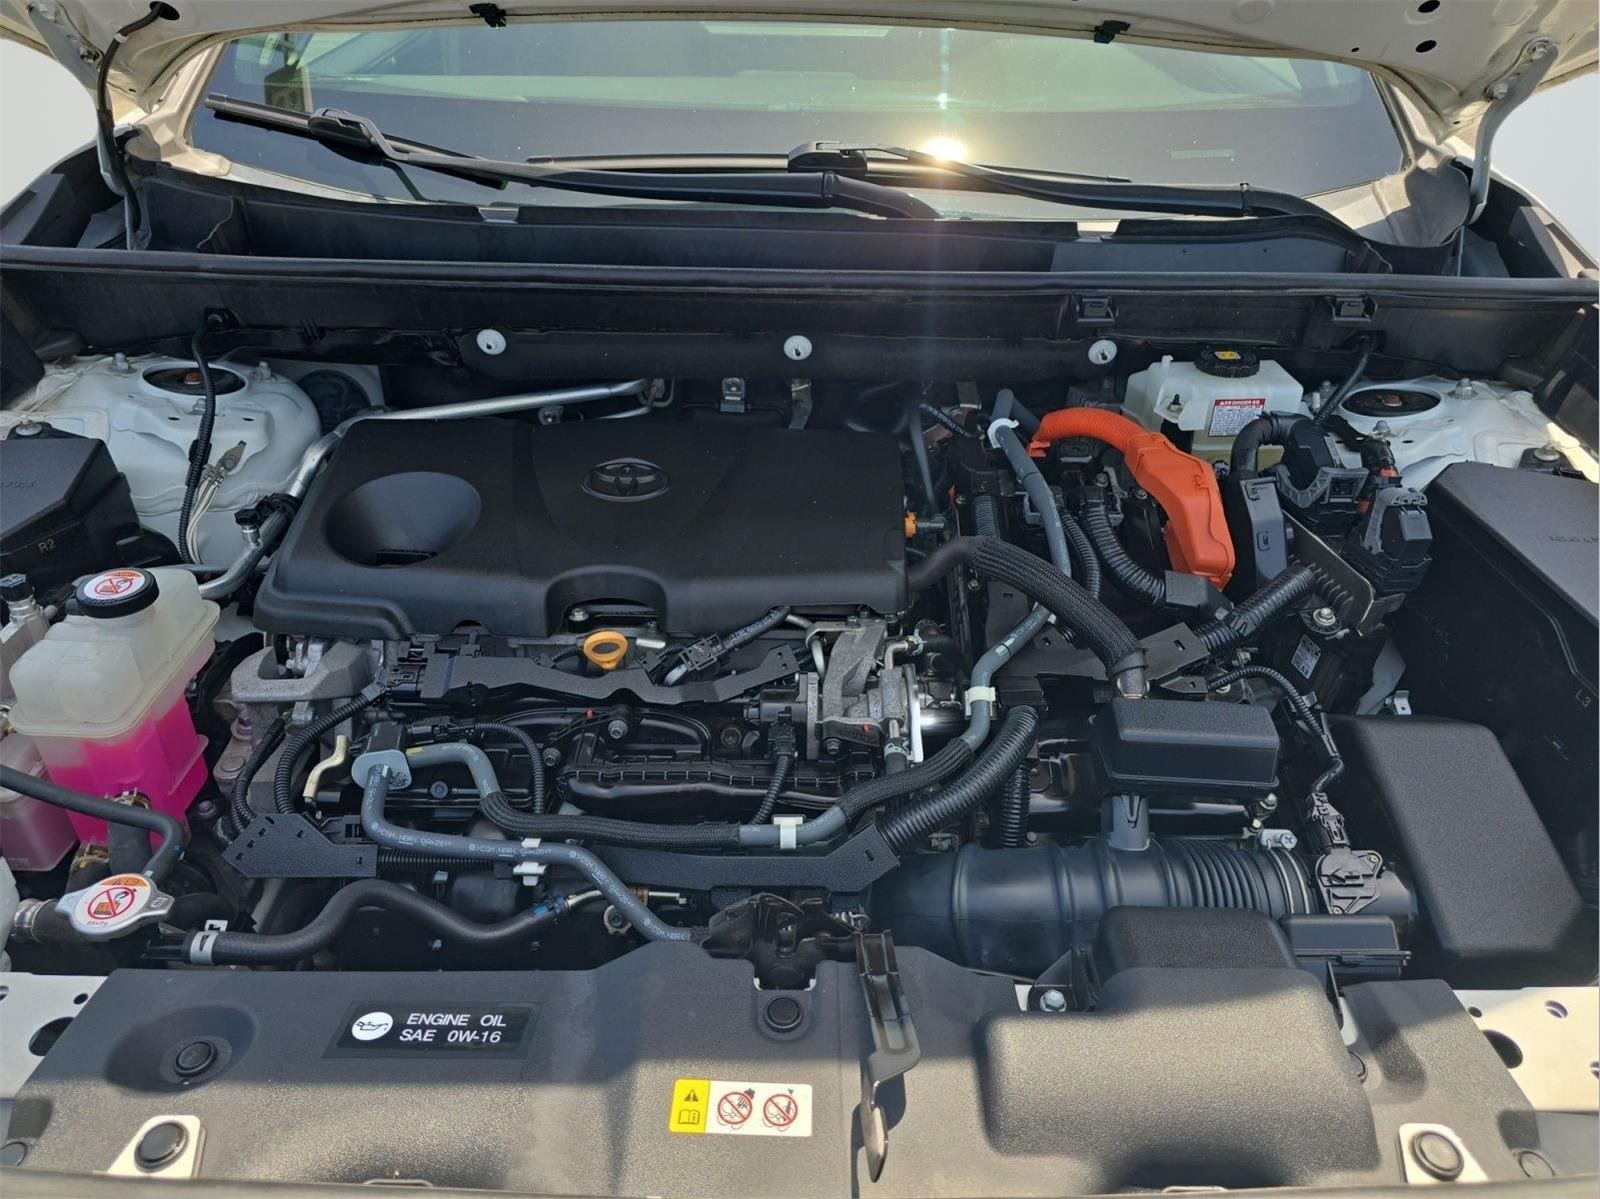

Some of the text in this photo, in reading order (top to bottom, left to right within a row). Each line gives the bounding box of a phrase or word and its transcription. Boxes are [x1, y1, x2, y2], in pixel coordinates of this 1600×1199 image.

[38, 538, 56, 554] R2
[1576, 689, 1592, 707] L3
[406, 1013, 506, 1027] ENGINE OIL
[399, 1029, 502, 1043] SAE 0W-16
